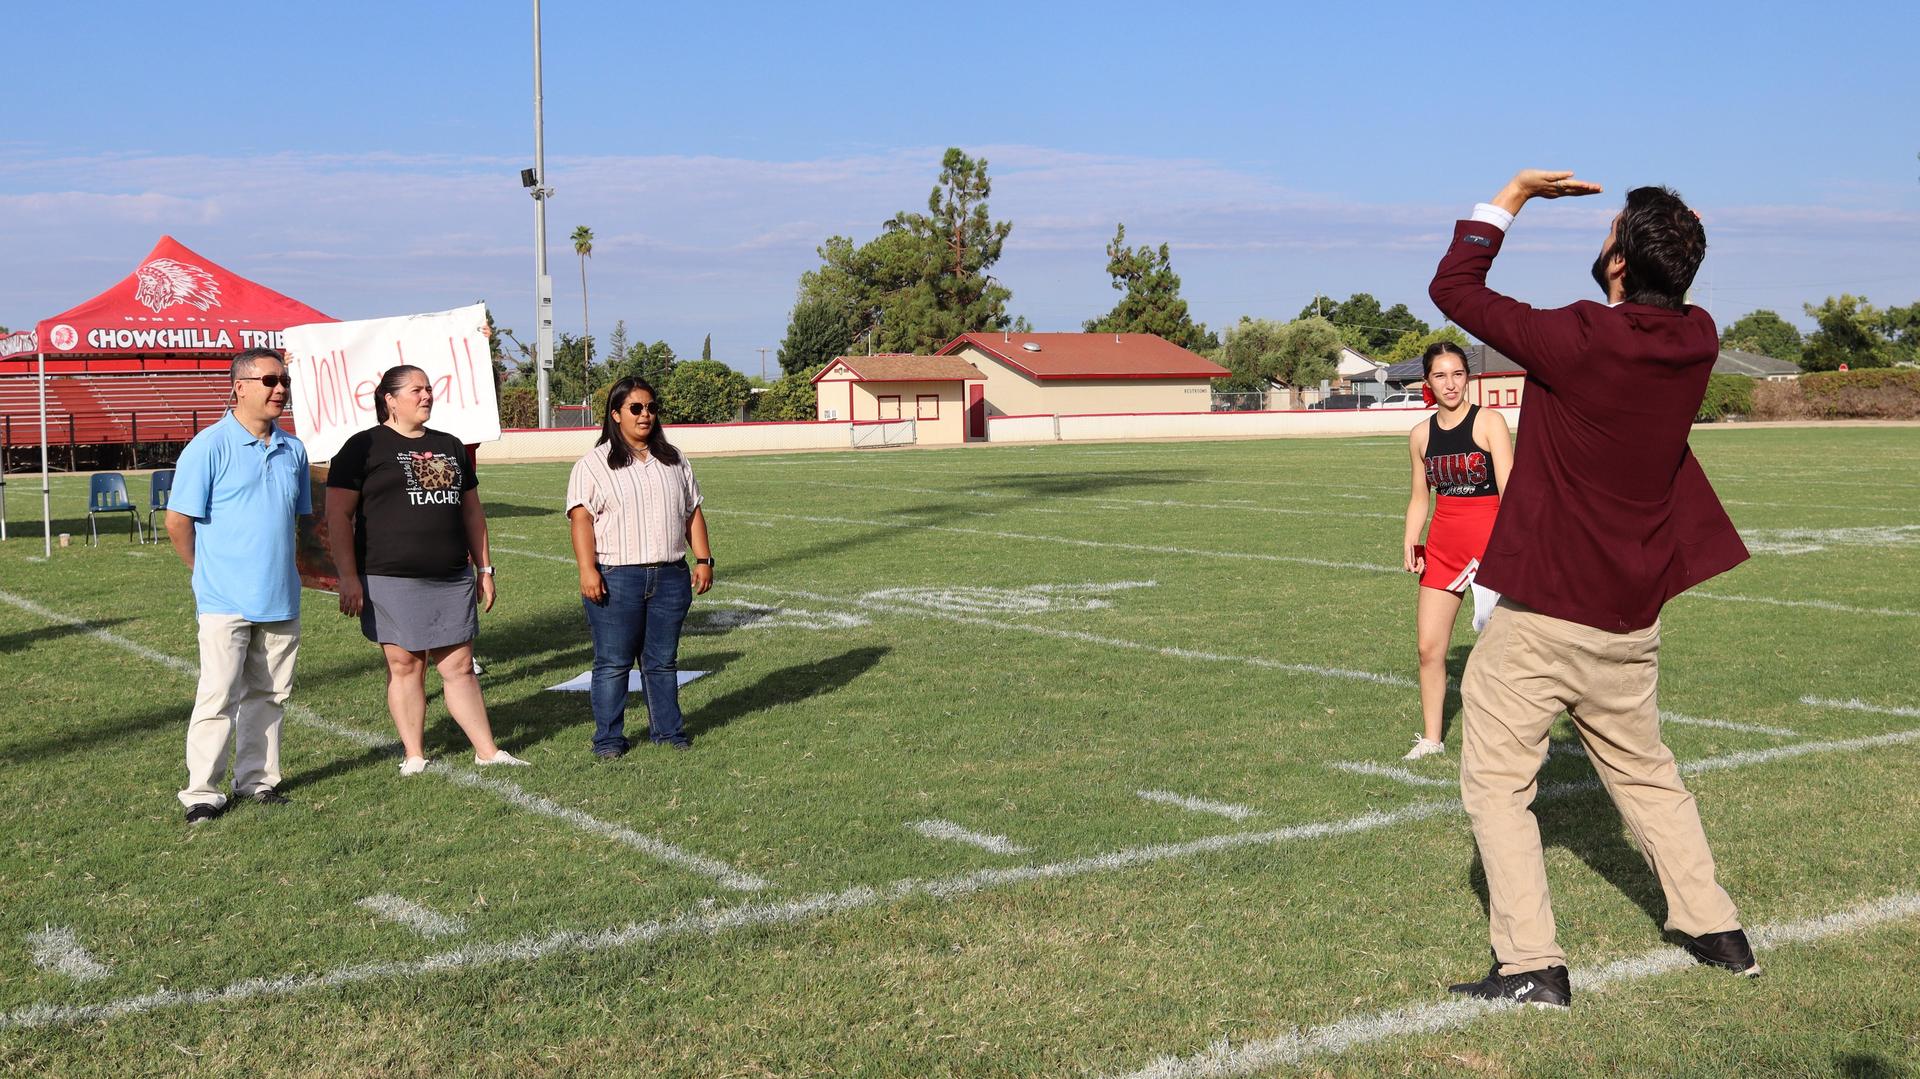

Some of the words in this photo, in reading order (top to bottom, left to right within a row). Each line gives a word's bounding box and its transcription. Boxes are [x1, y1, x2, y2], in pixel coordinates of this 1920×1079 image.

[87, 328, 235, 350] CHOWCHILLA
[297, 336, 480, 433] Volleall
[408, 490, 461, 505] TEACHER
[1514, 981, 1535, 999] FILA
